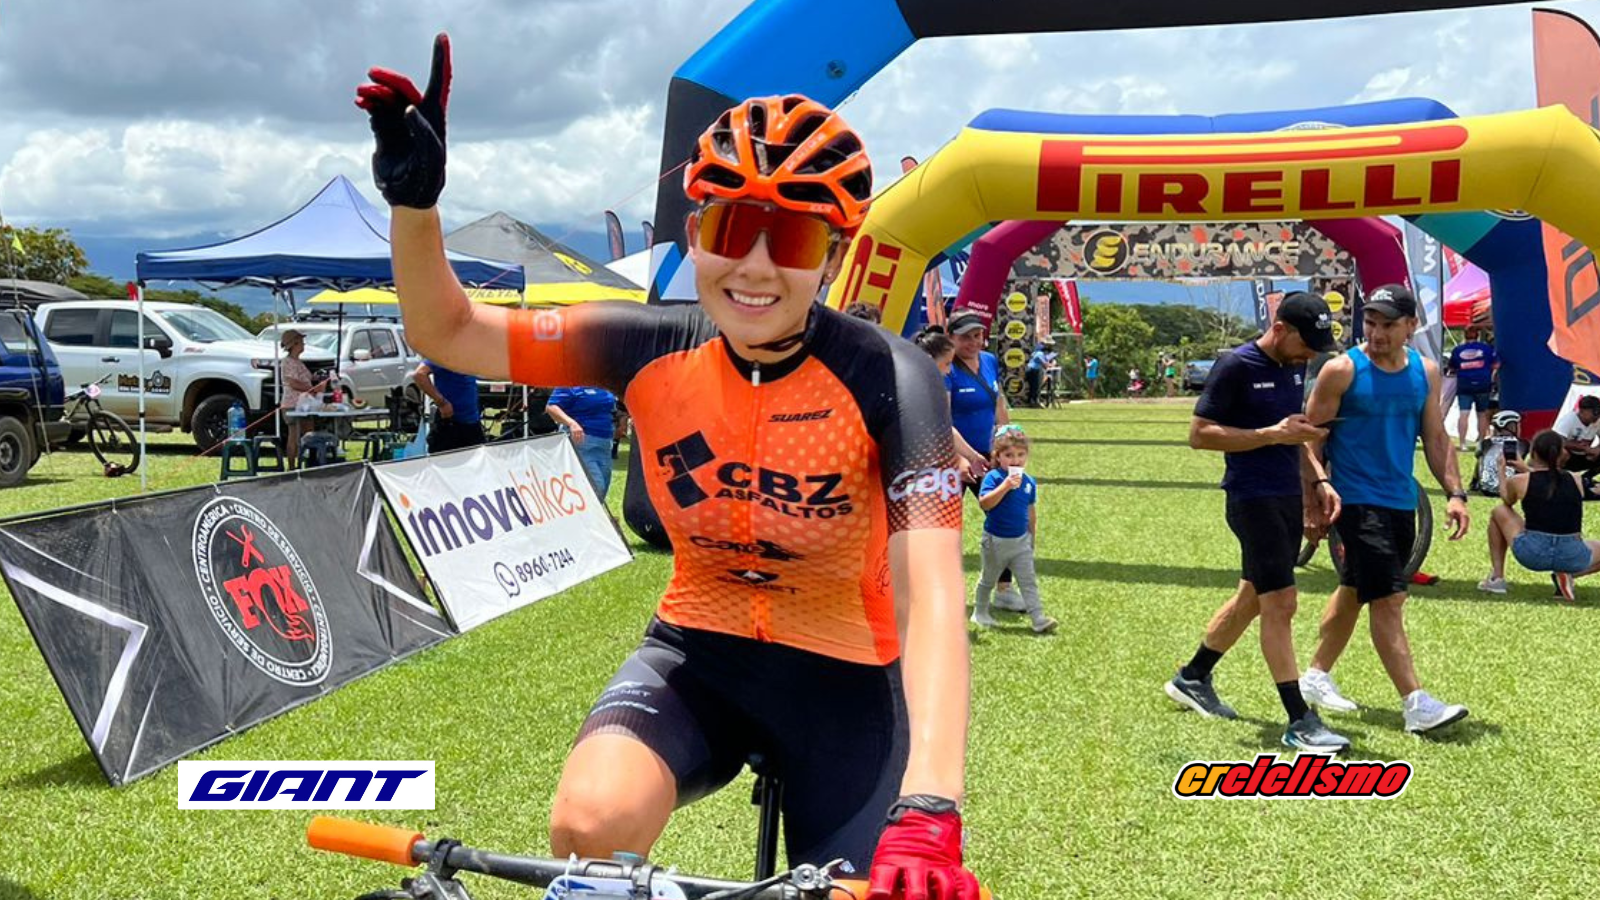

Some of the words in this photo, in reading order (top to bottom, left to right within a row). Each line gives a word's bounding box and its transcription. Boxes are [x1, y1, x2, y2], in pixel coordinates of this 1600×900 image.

[1036, 124, 1469, 214] PIRELLI
[1133, 241, 1299, 267] ENDURANCE
[768, 409, 833, 423] SUAREZ
[717, 462, 850, 505] CBZ
[715, 488, 853, 519] ASFALTOS
[234, 504, 267, 529] CENTRO
[267, 525, 280, 543] DE
[279, 540, 314, 594] SERVICIO
[515, 548, 576, 583] 8960-7244
[223, 565, 315, 641] FOX
[209, 595, 250, 654] SERVICIO
[250, 651, 267, 669] DE
